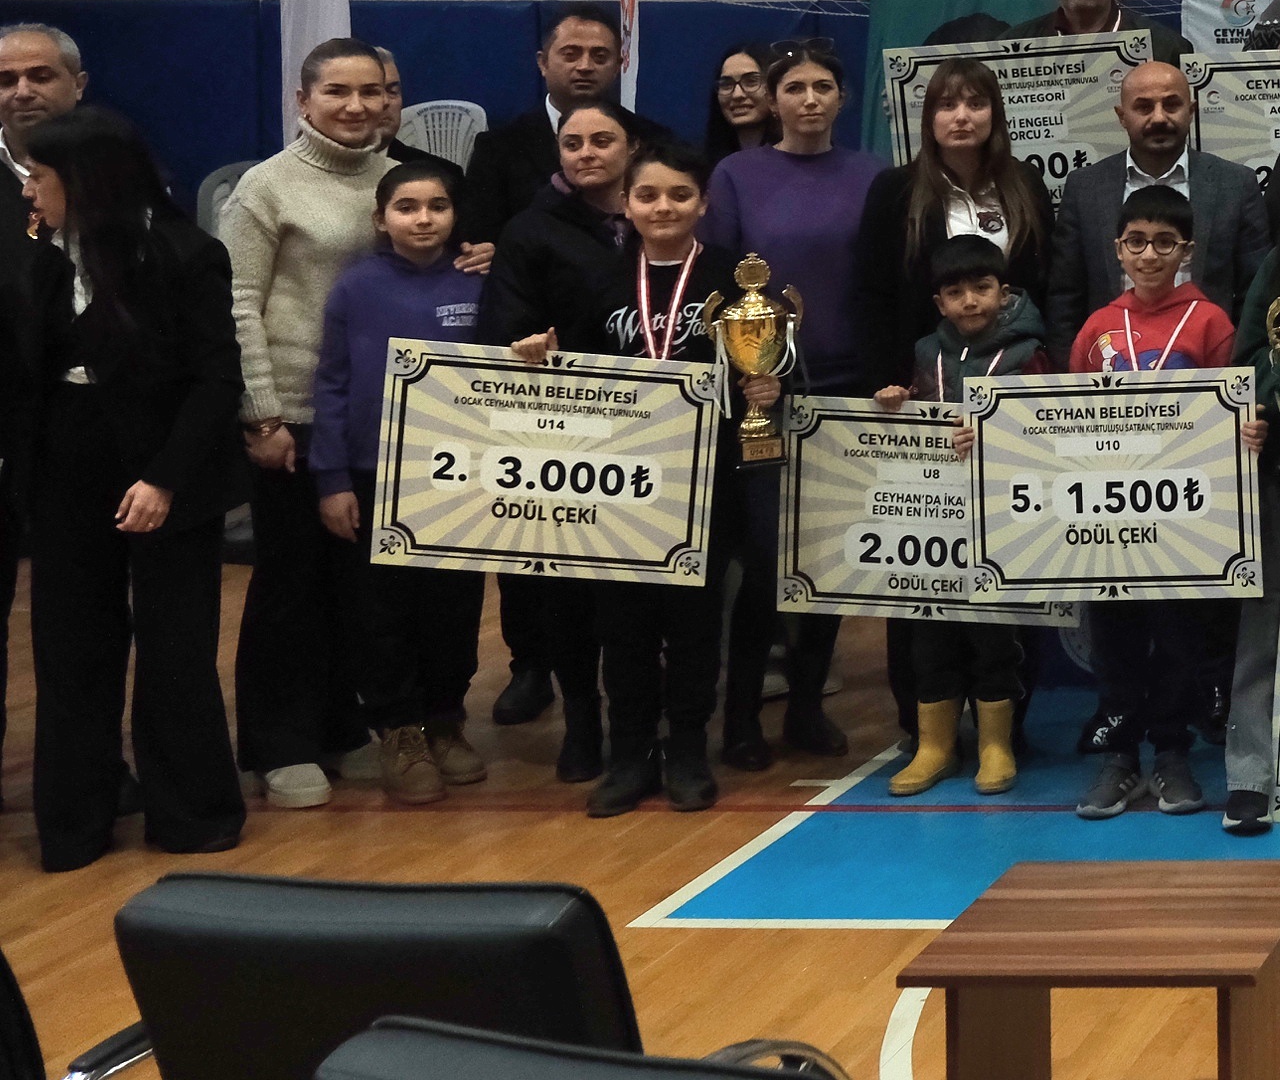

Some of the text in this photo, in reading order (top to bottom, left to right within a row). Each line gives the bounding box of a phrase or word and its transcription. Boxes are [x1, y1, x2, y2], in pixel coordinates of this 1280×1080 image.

[1012, 60, 1086, 78] BELEDİYESİ
[1008, 90, 1066, 105] KATEGORİ
[1019, 113, 1064, 128] ENGELLİ
[470, 379, 638, 405] CEYHAN BELEDİYESİ
[453, 395, 460, 405] 6
[460, 396, 484, 406] OCAK
[572, 404, 608, 418] SATRANÇ
[608, 407, 651, 420] TURNUVASI
[1035, 401, 1180, 422] CEYHAN BELEDİYESİ
[537, 418, 565, 431] U14
[858, 432, 921, 448] CEYHAN
[1095, 440, 1120, 452] U10
[432, 451, 468, 482] 2.
[923, 468, 940, 480] U8
[1011, 484, 1042, 513] 5.
[490, 499, 597, 528] ÖDÜL ÇEKİ
[872, 504, 939, 519] EDEN EN İYİ
[1065, 522, 1158, 550] ÖDÜL ÇEKİ
[887, 573, 963, 596] ÖDÜL ÇEKİ
